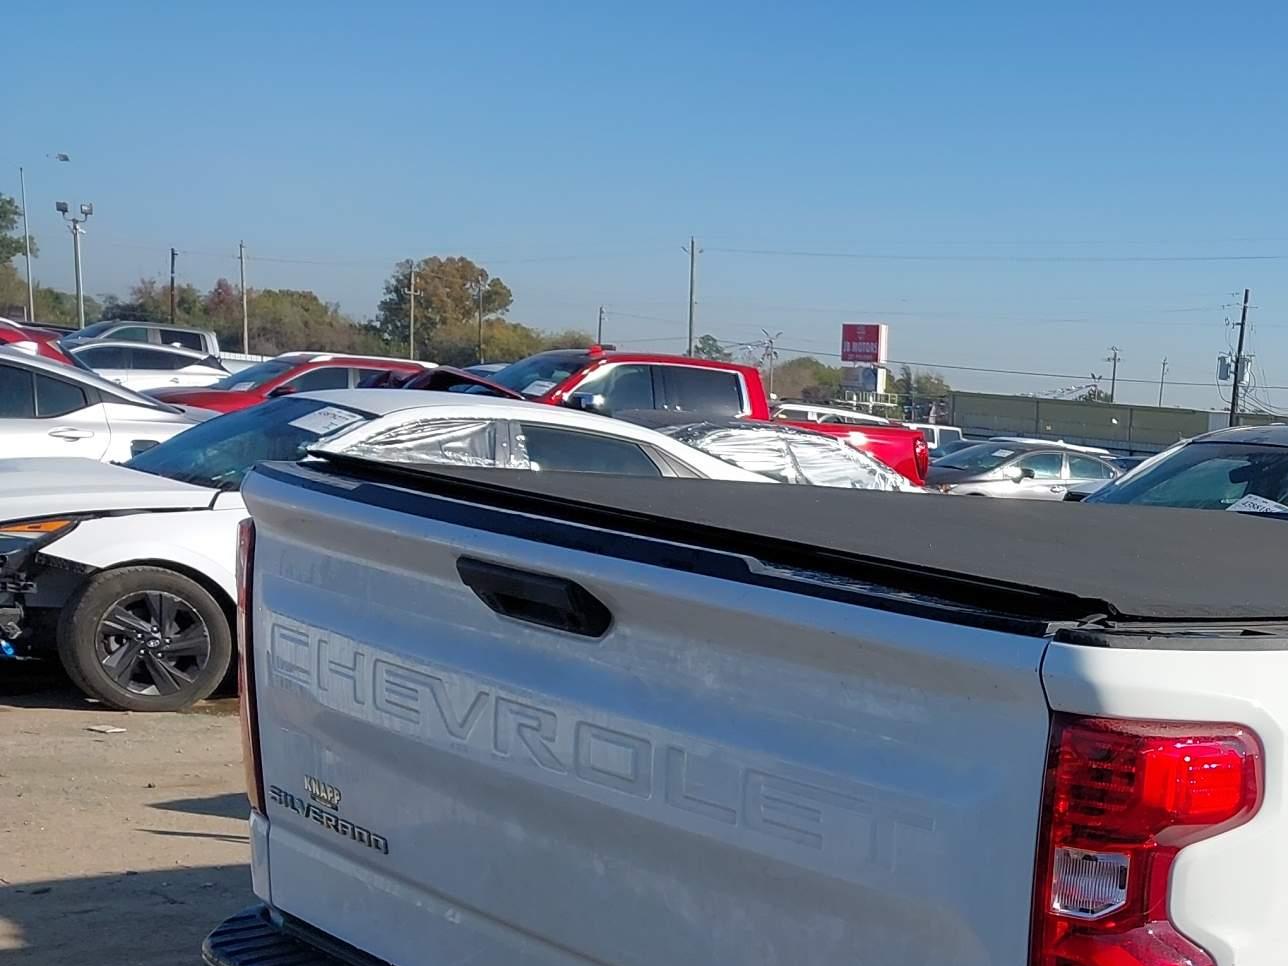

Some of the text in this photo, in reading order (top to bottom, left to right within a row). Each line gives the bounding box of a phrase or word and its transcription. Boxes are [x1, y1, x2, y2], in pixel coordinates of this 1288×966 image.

[267, 622, 936, 872] CHEVROLET
[268, 785, 389, 854] SILVERADO
[304, 775, 341, 805] KNAPP
